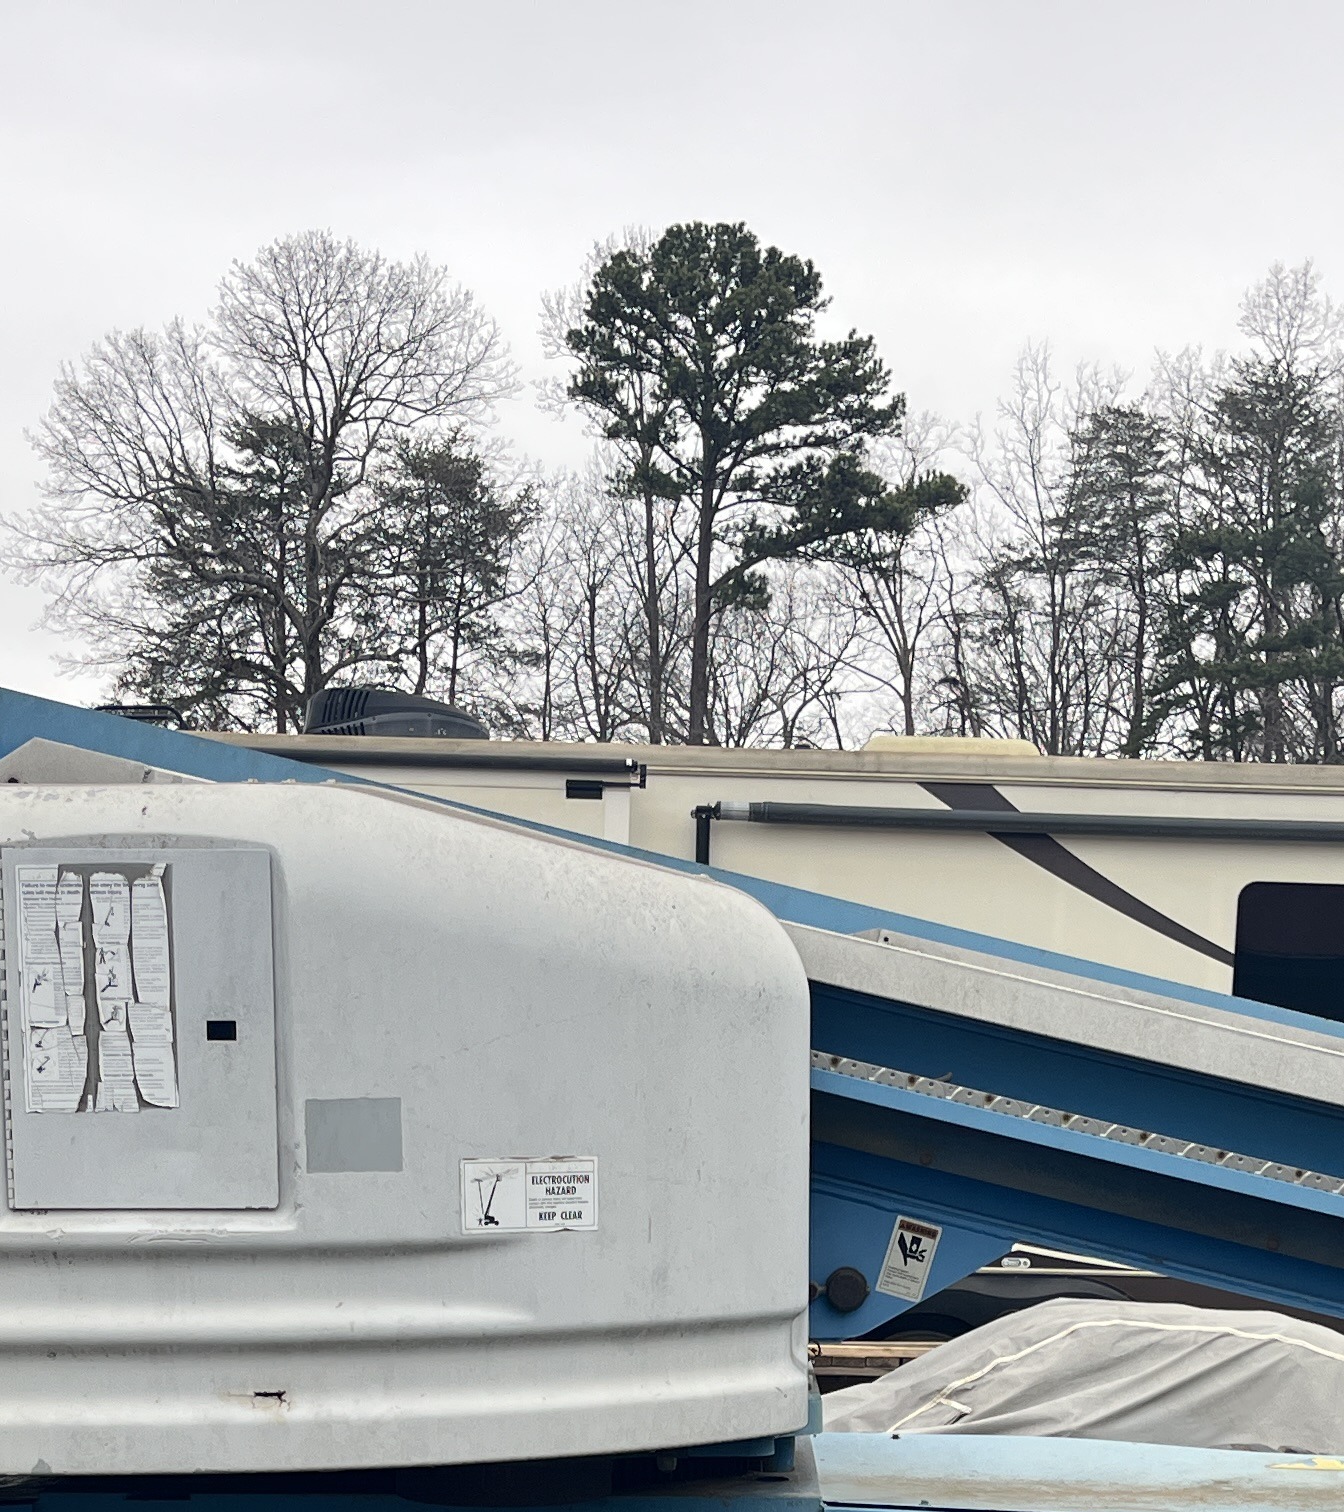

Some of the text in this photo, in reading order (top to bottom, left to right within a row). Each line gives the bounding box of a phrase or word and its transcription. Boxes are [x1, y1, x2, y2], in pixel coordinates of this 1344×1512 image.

[532, 1175, 589, 1185] ELECTROCUTION
[546, 1186, 576, 1195] HAZARD
[539, 1211, 582, 1221] KEEP CLEAR
